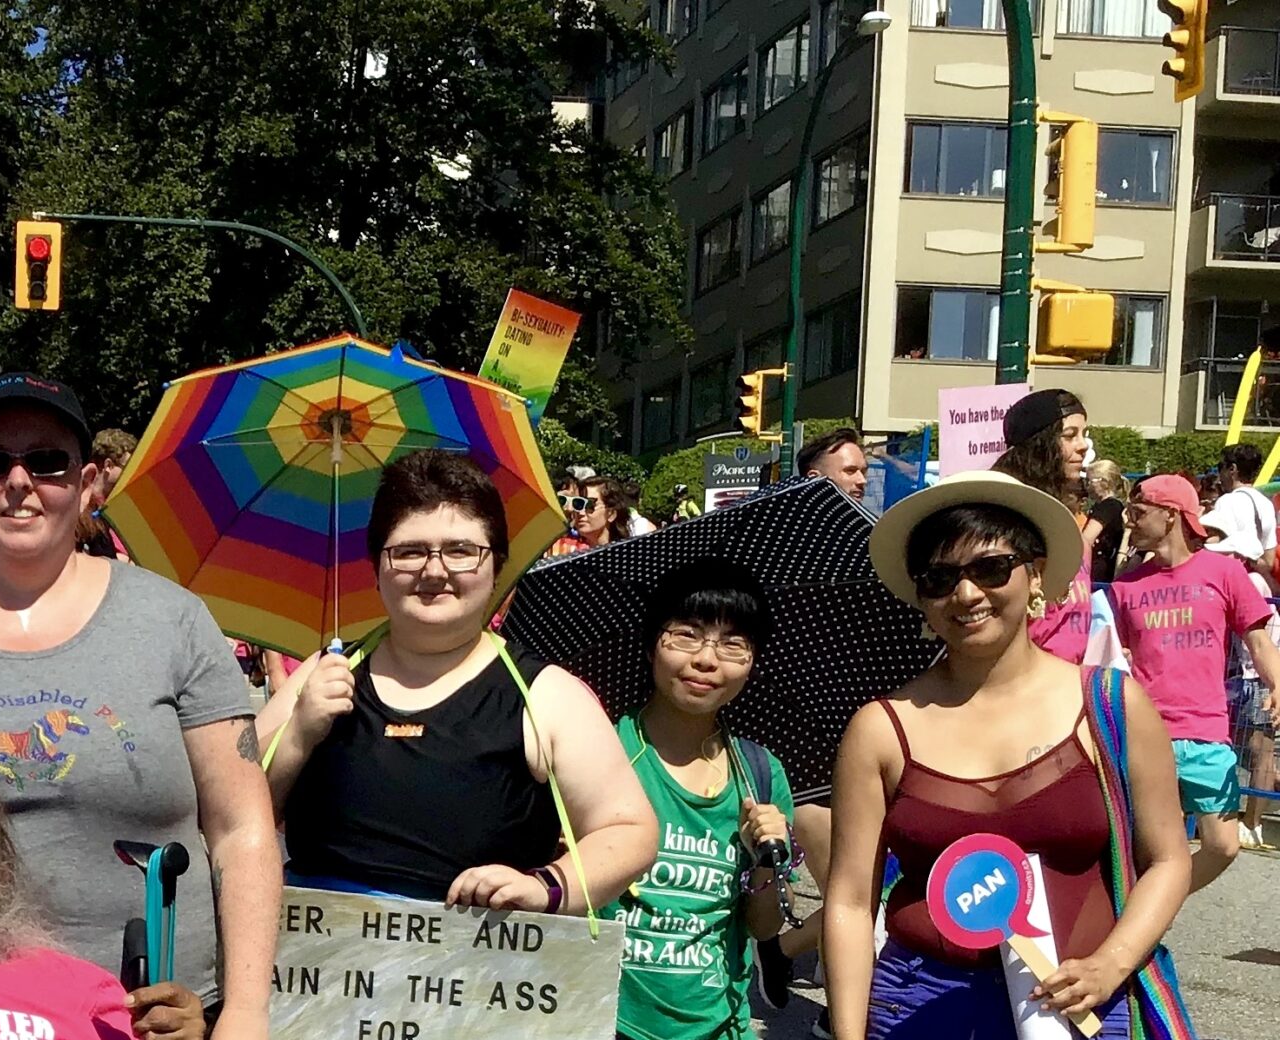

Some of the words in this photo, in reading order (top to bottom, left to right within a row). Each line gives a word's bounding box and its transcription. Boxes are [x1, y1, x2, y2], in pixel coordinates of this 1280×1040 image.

[504, 325, 533, 347] DATING
[498, 342, 512, 357] ON
[491, 359, 500, 372] A
[949, 409, 967, 425] You
[968, 408, 989, 424] have
[991, 406, 1005, 421] the
[968, 440, 978, 456] to
[1143, 606, 1193, 630] WITH
[1161, 629, 1215, 651] PRIDE
[664, 823, 719, 858] kinds
[956, 867, 1008, 915] PAN
[615, 904, 643, 928] all
[651, 907, 708, 934] kinds
[362, 911, 443, 944] HERE
[473, 920, 545, 953] AND
[344, 970, 375, 999] IN
[407, 975, 464, 1007] THE
[488, 981, 559, 1014] ASS
